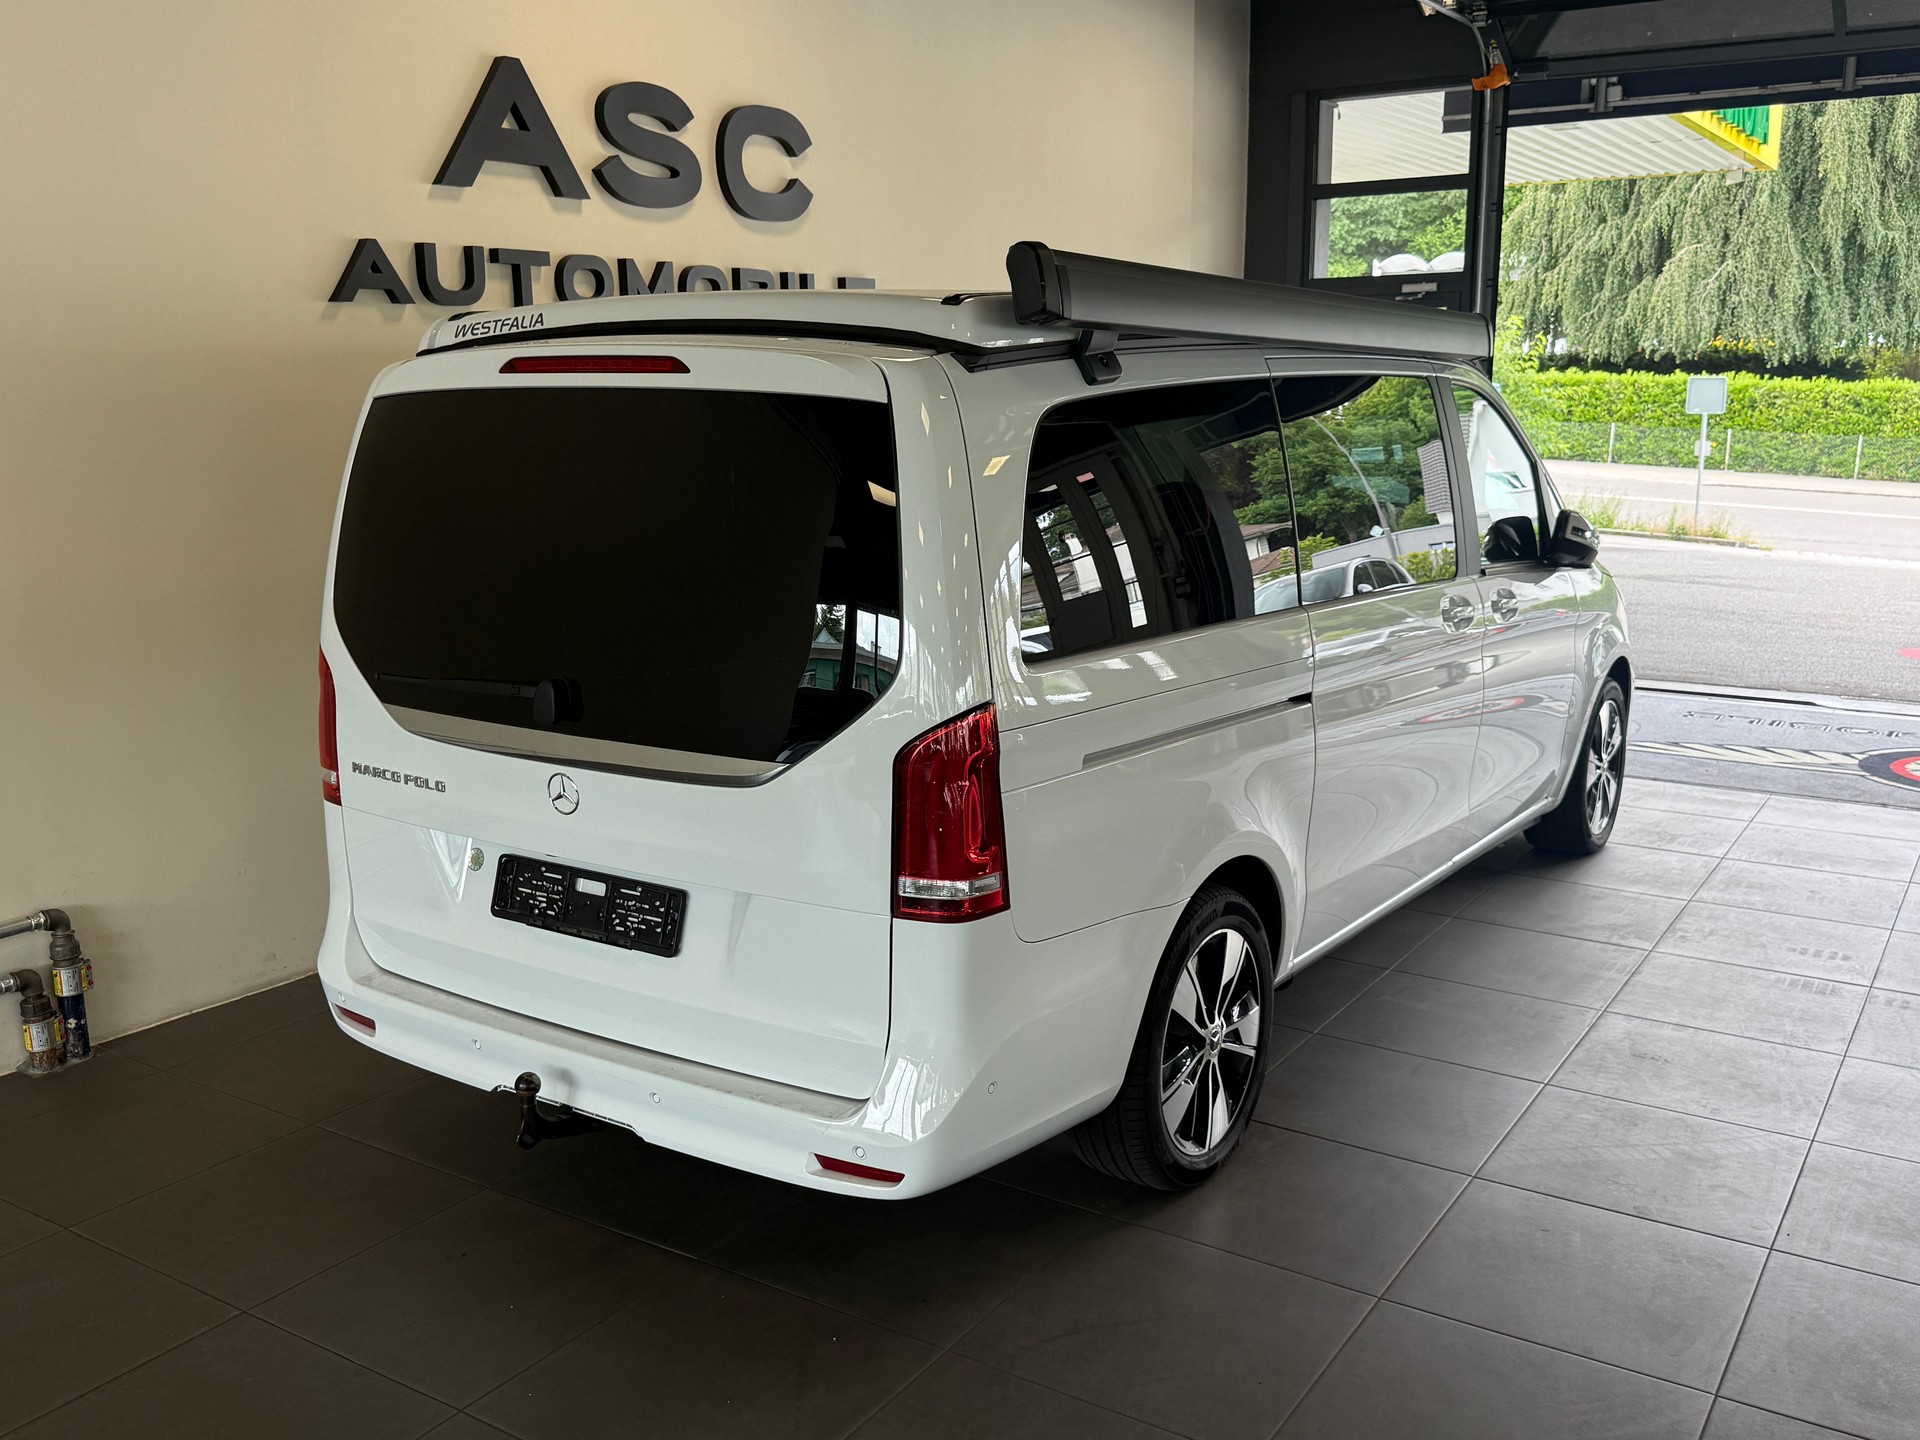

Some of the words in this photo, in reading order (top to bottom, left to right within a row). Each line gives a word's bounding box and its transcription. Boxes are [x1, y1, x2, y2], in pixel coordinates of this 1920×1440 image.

[432, 55, 814, 222] ASC
[454, 312, 545, 339] WESTFALIA
[352, 761, 402, 784] MARCO
[403, 773, 446, 793] POLO
